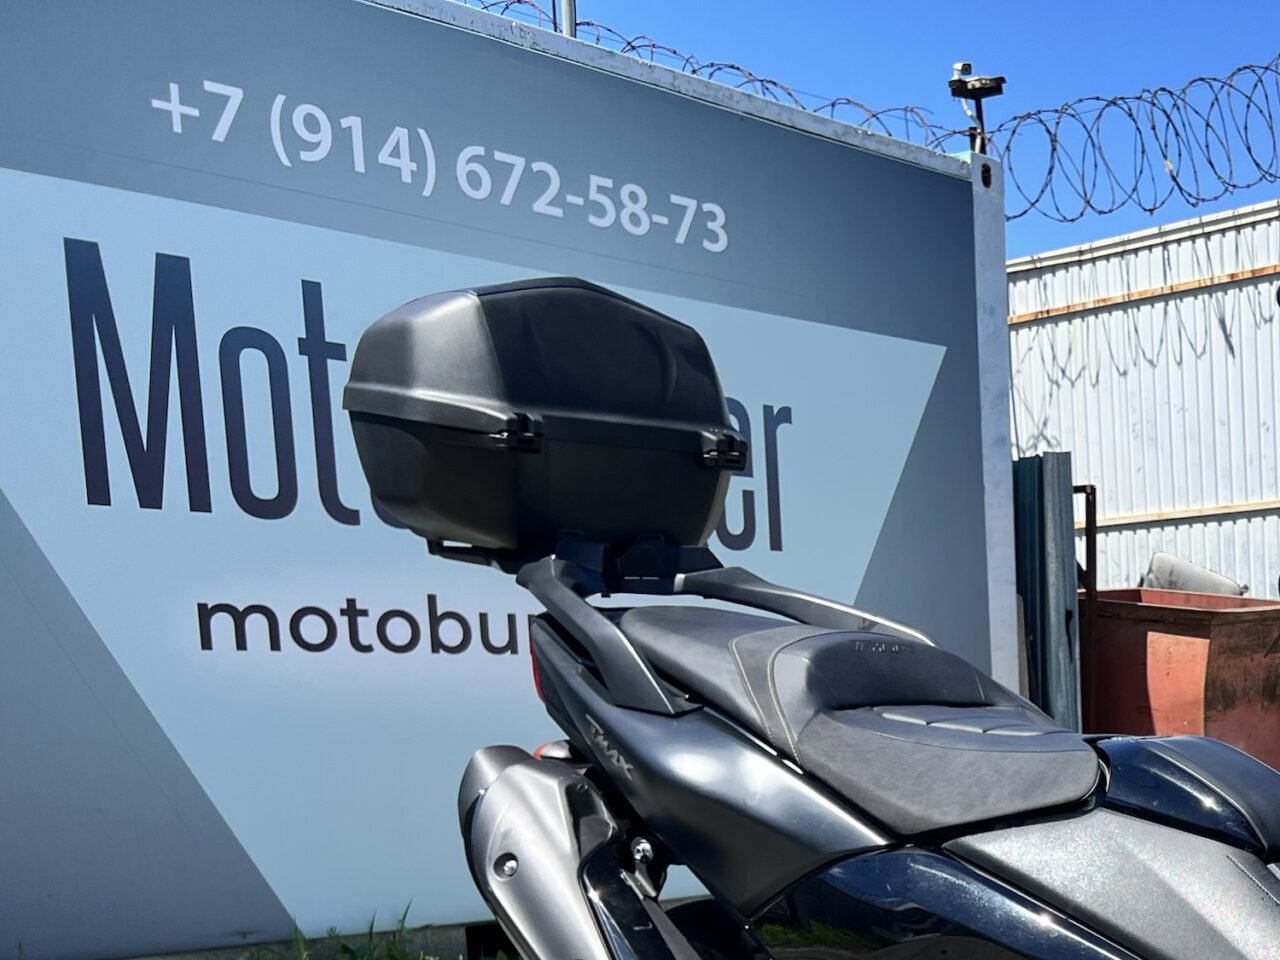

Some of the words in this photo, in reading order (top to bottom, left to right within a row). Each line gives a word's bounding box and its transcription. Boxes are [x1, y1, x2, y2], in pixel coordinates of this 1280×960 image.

[151, 82, 244, 143] +7
[270, 93, 436, 197] (914)
[456, 145, 728, 252] 672-58-73
[197, 594, 537, 656] motobu
